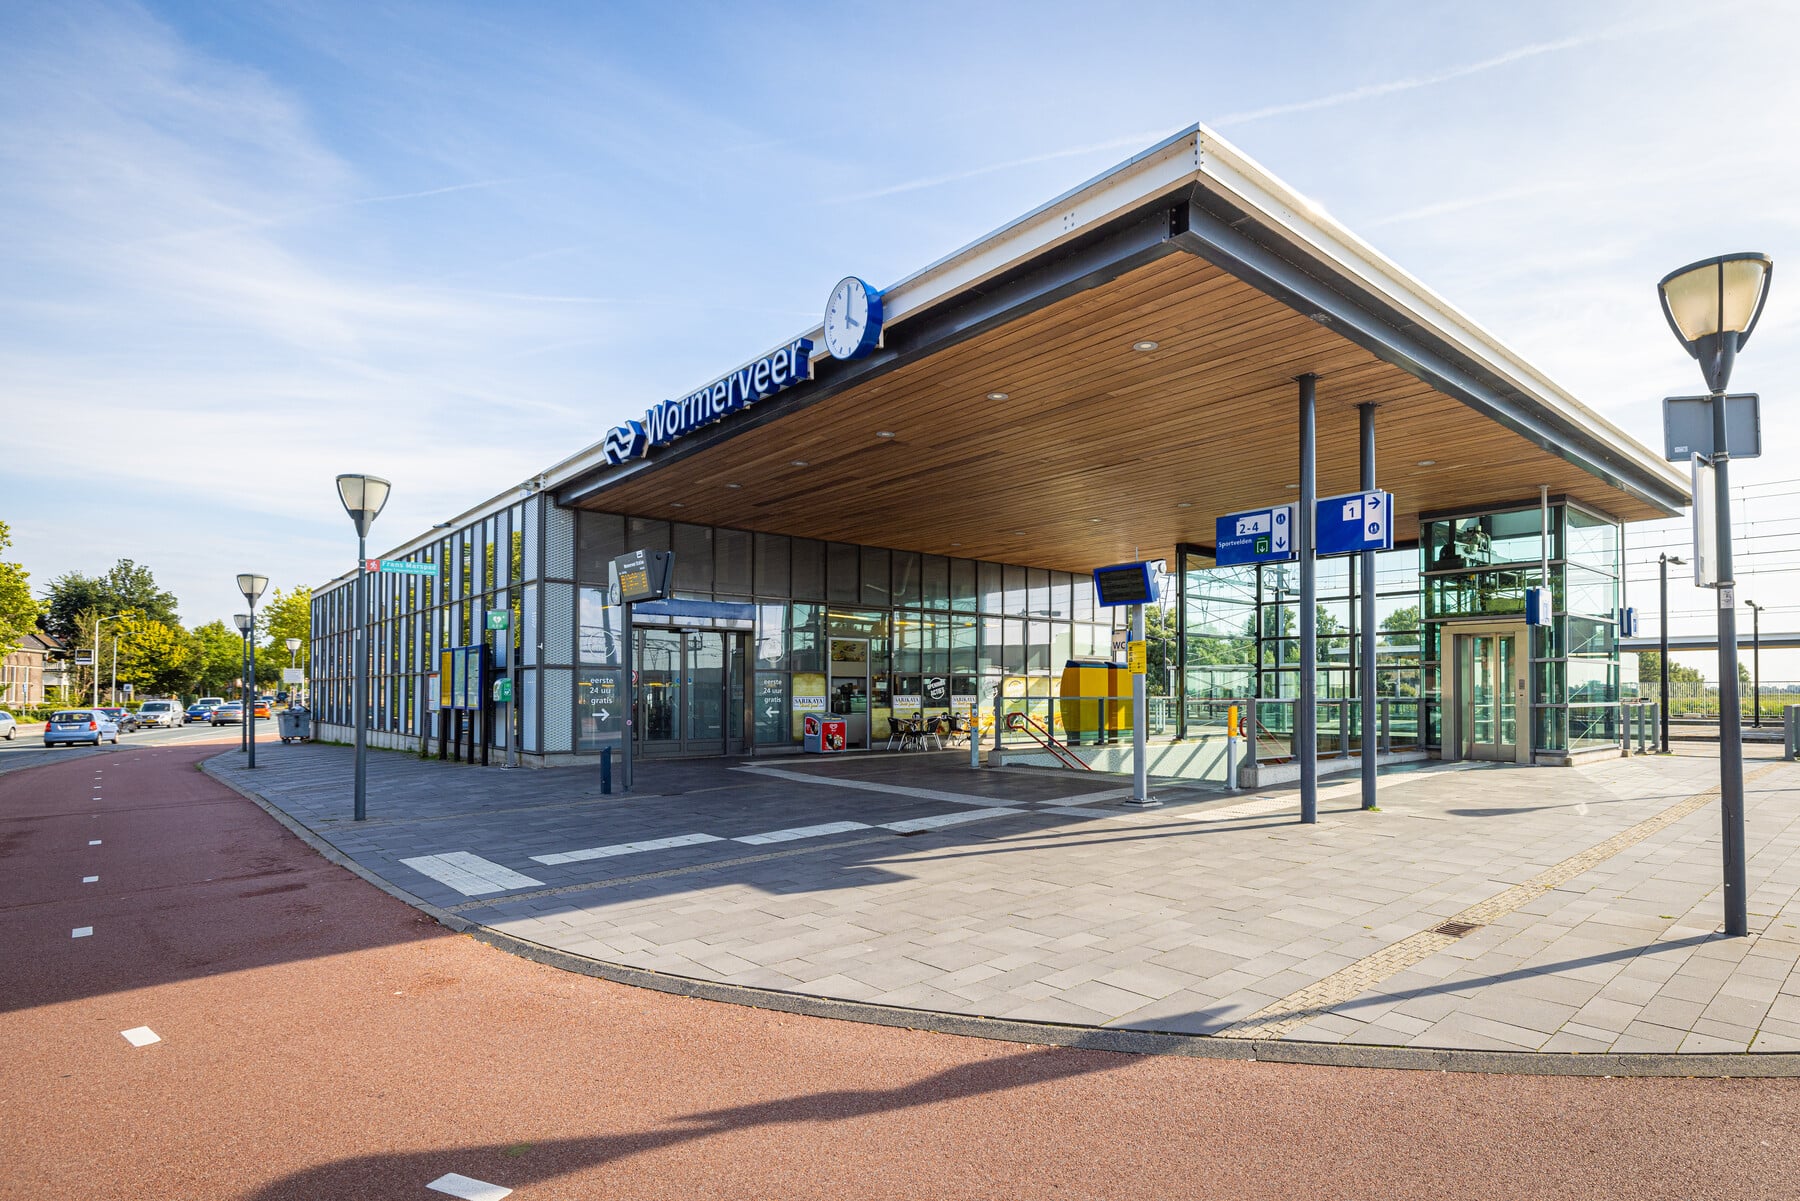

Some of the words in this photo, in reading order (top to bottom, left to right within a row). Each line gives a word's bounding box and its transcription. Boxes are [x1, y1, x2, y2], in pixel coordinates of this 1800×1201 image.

[646, 337, 811, 446] Wormerveer
[1349, 506, 1354, 518] 1
[1239, 521, 1259, 534] 2-4
[1218, 538, 1252, 549] Sportvelden
[382, 560, 403, 568] Frans
[1112, 641, 1126, 650] WC
[590, 696, 613, 706] gratis
[764, 696, 782, 704] gratis
